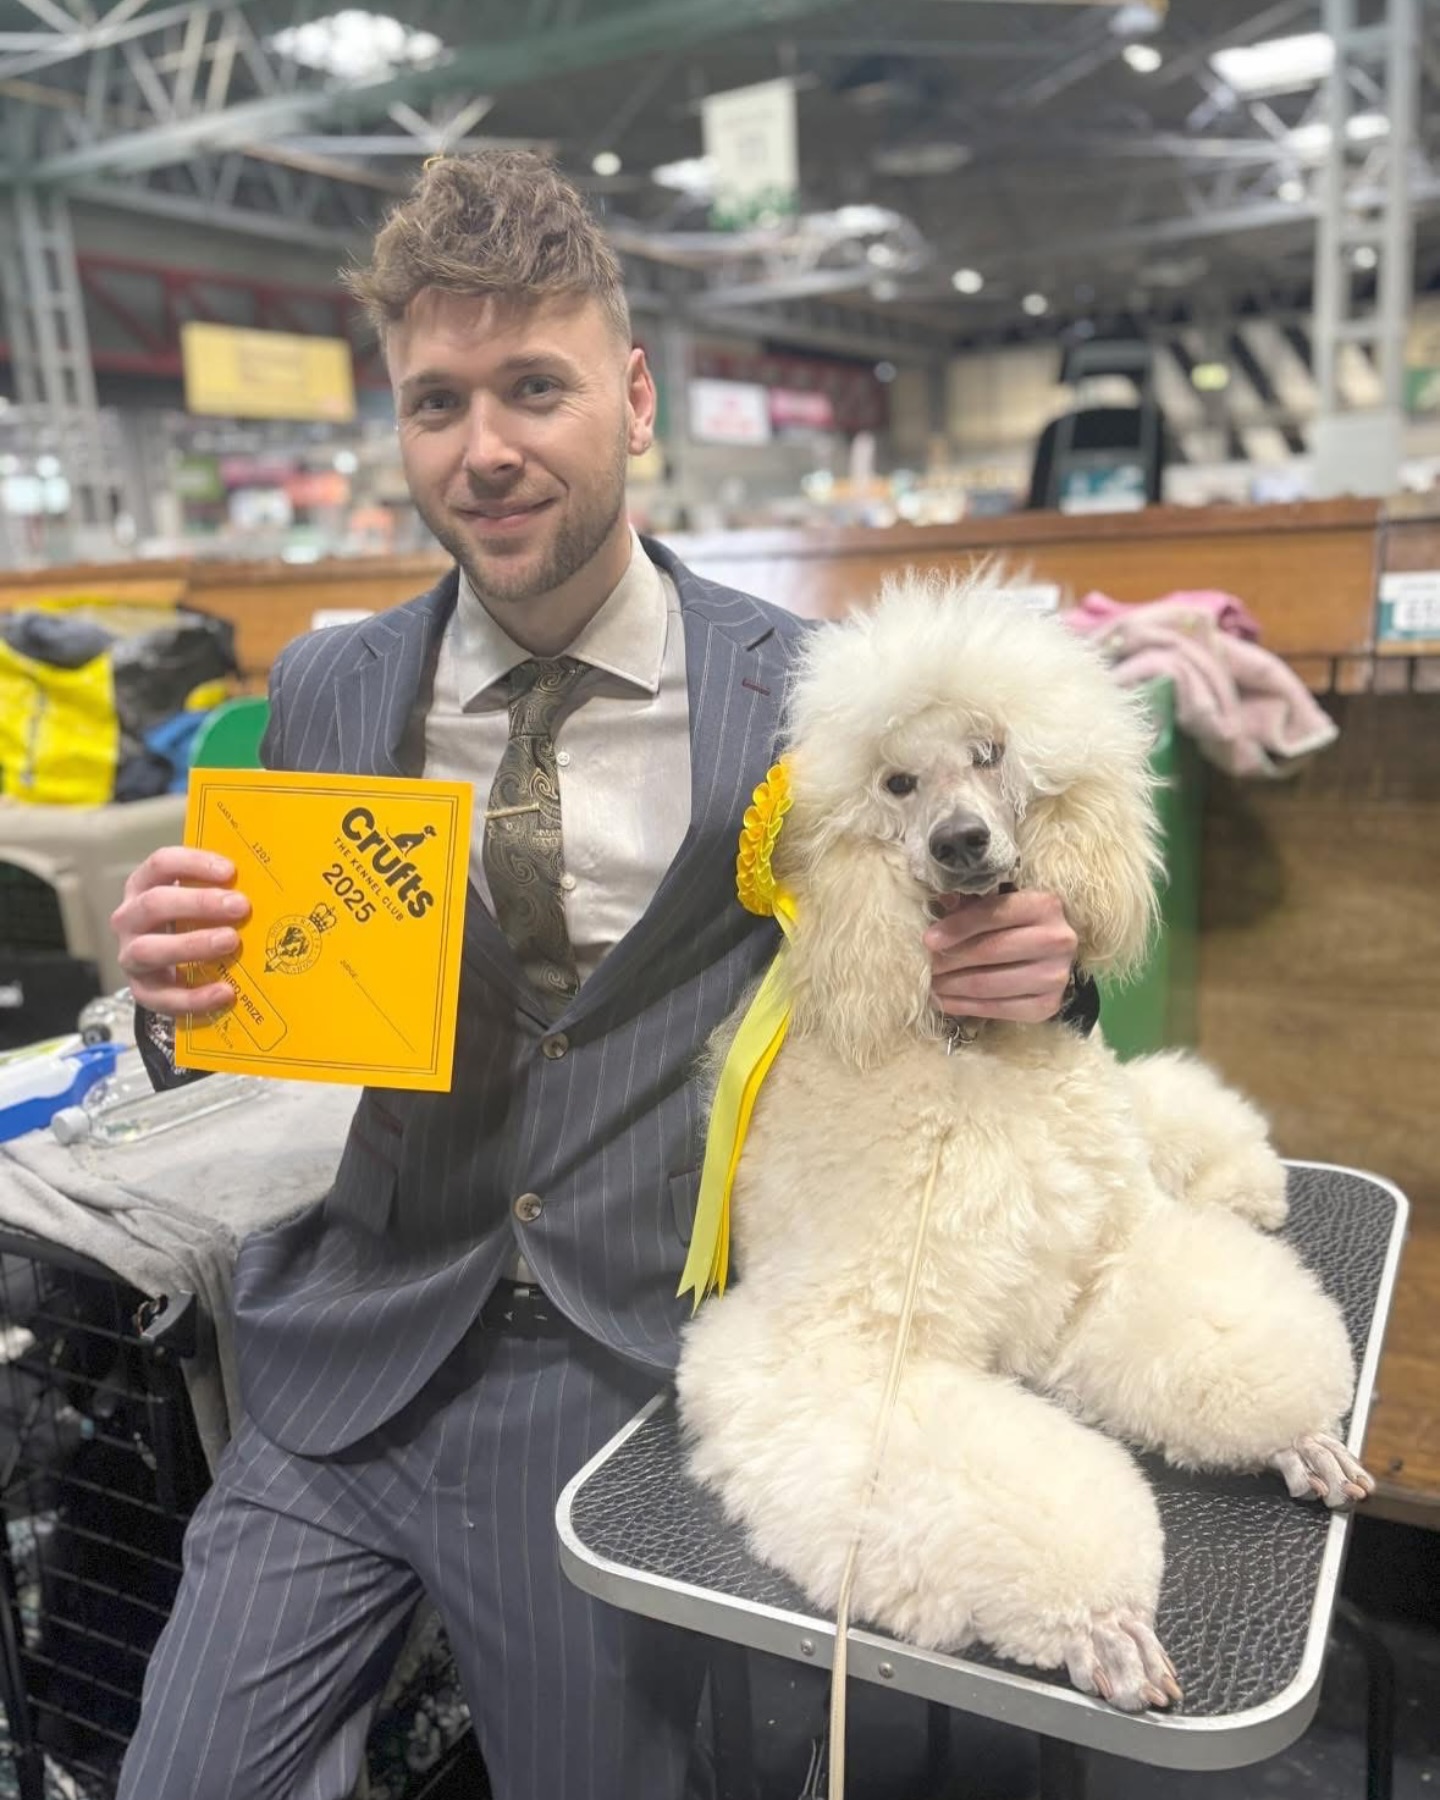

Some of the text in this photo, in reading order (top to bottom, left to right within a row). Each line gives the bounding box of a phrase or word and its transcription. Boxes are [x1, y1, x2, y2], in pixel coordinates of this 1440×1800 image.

[252, 841, 271, 864] 1202
[333, 837, 404, 921] THE KENNEL CLUB
[341, 806, 435, 918] Crufts
[321, 862, 377, 923] 2025
[240, 993, 265, 1026] PRIZE
